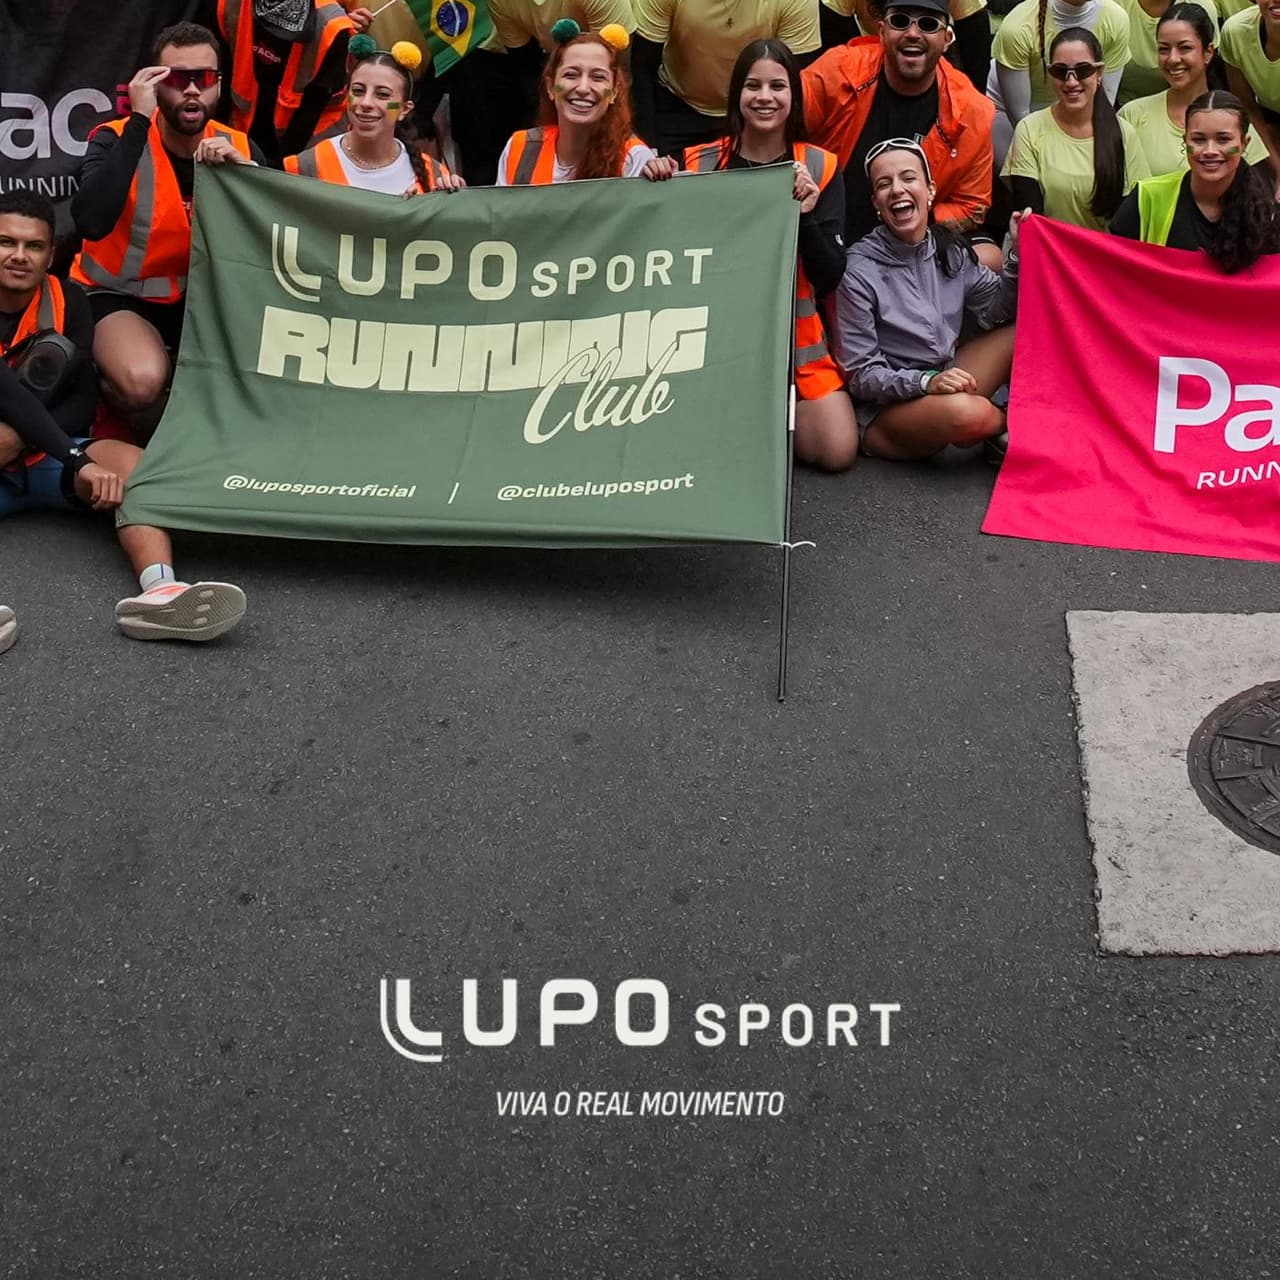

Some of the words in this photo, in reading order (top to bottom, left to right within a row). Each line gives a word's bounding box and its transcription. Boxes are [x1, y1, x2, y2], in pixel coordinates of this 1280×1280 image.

[272, 223, 518, 302] LUPO
[530, 247, 714, 298] SPORT
[257, 305, 709, 392] RUNNING
[523, 339, 677, 445] Club
[223, 474, 417, 498] @luposportoficial
[496, 472, 695, 501] @clubeluposport
